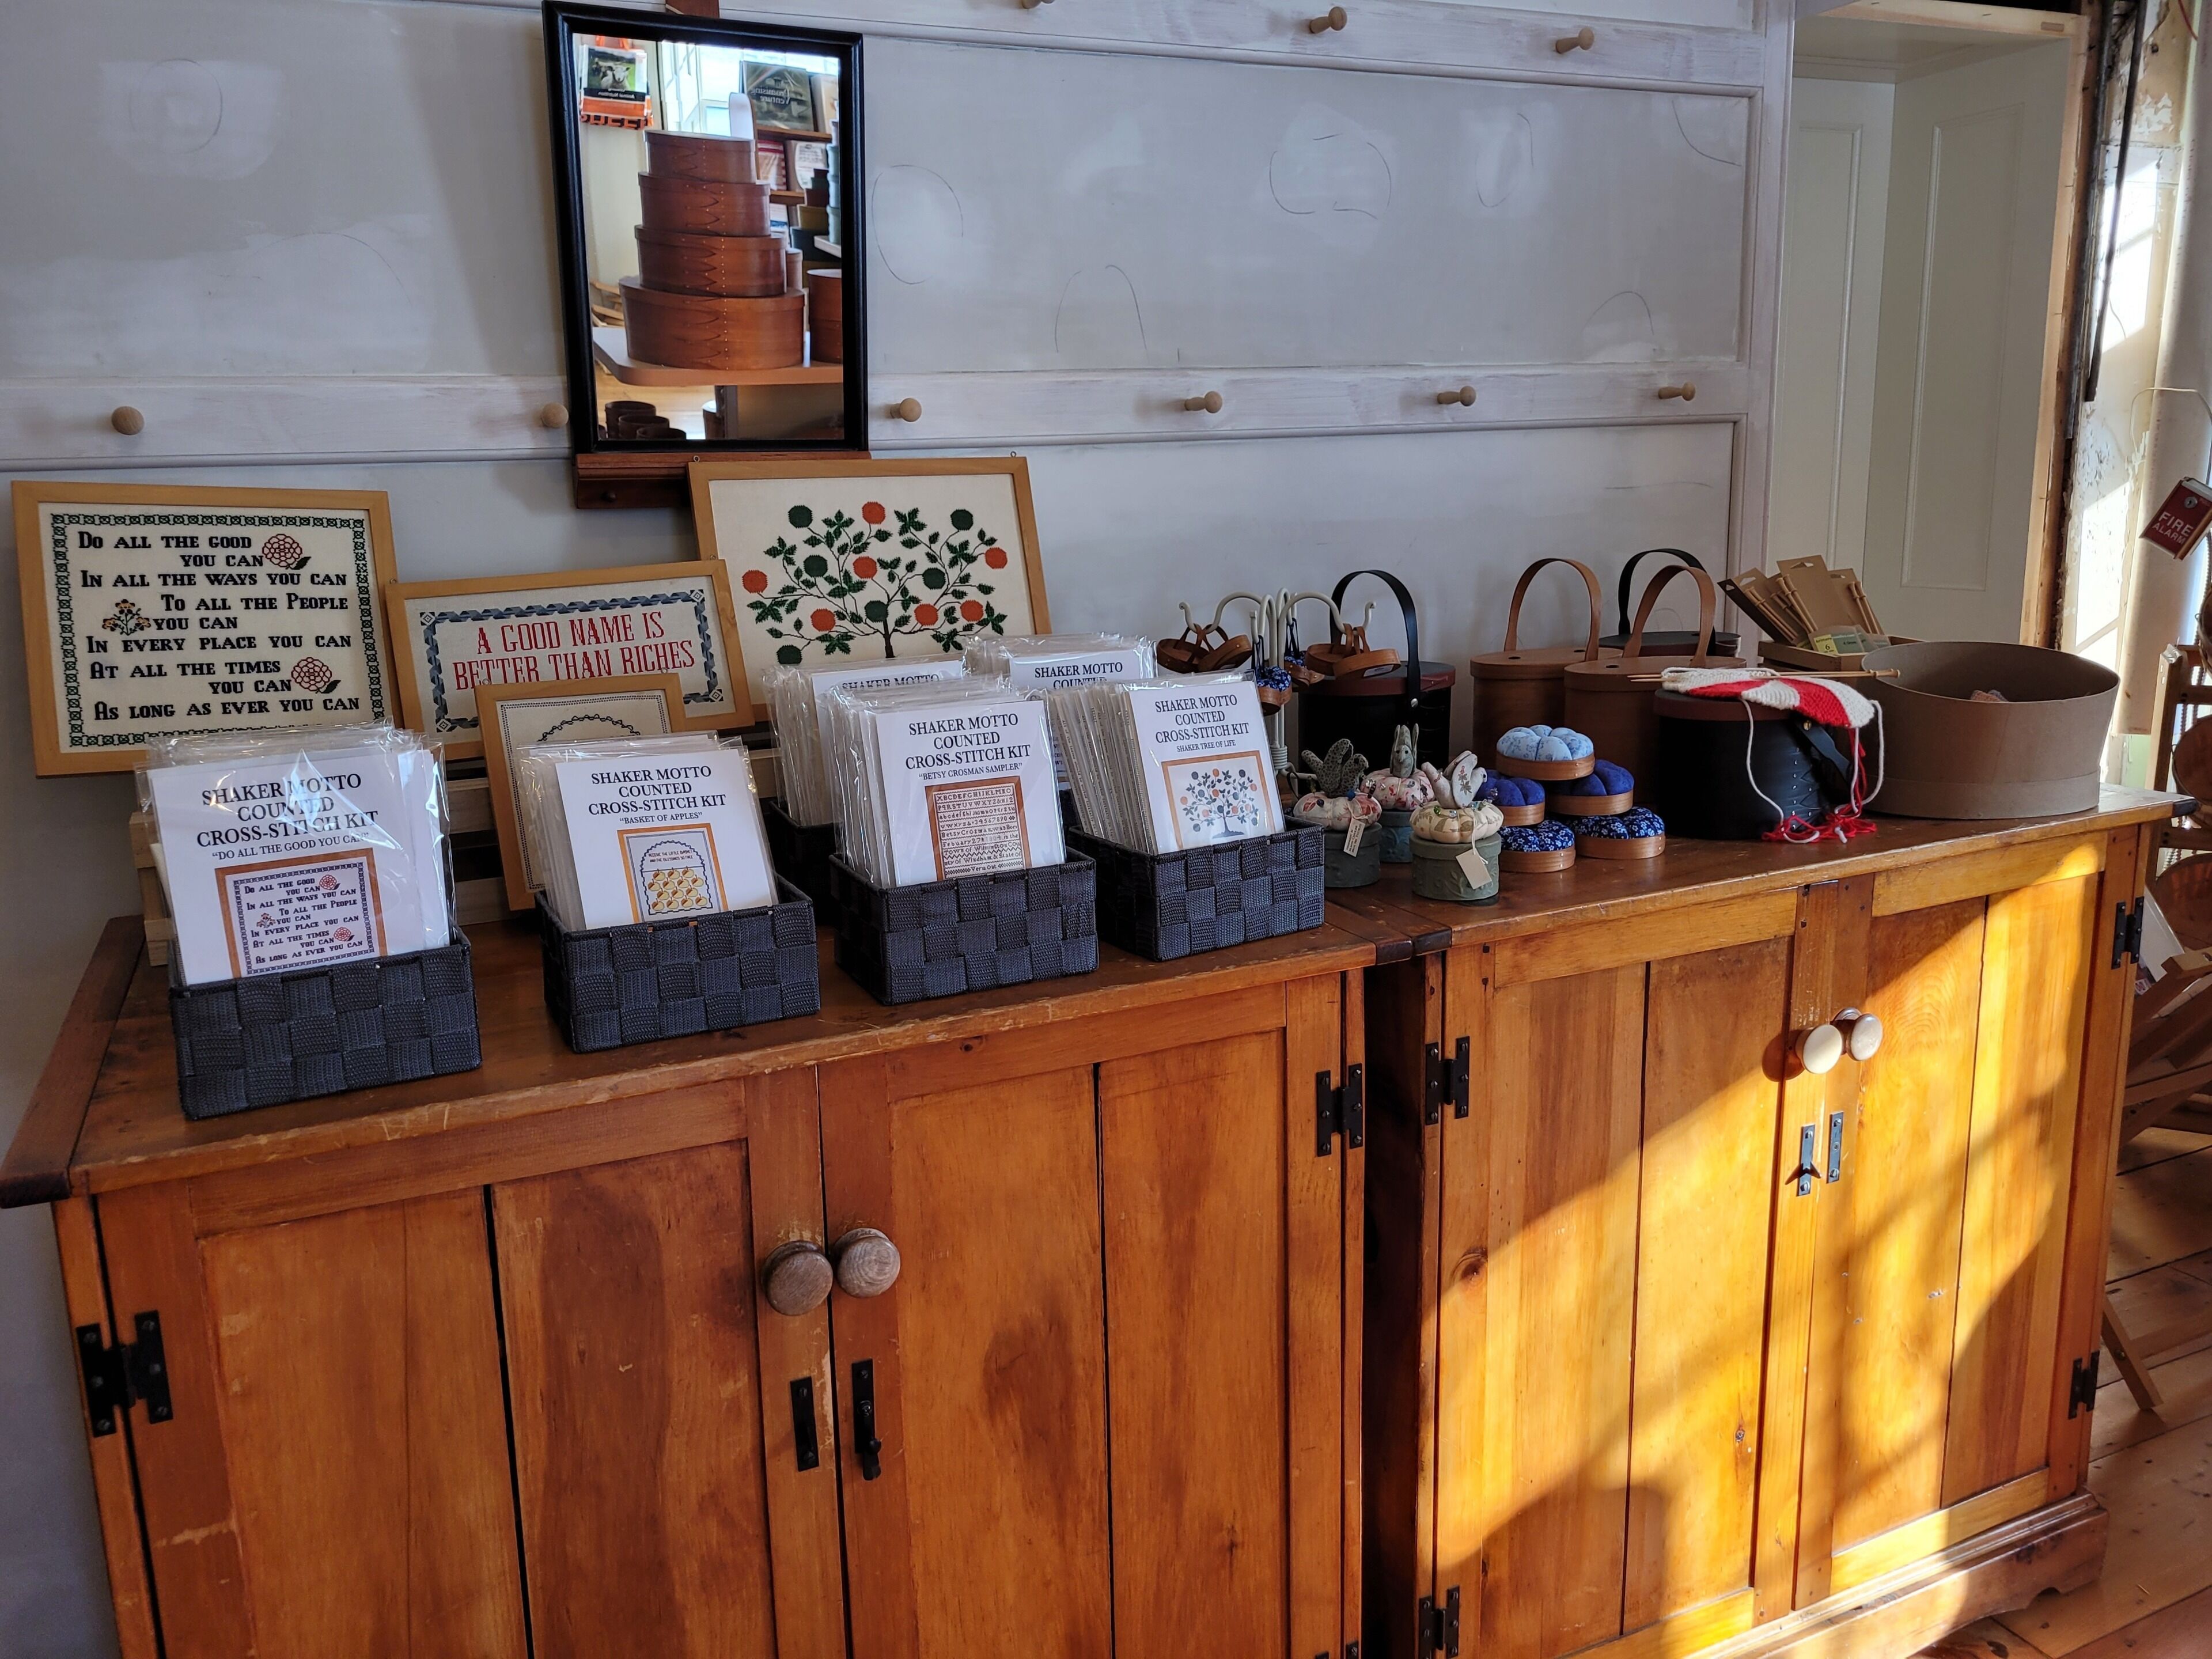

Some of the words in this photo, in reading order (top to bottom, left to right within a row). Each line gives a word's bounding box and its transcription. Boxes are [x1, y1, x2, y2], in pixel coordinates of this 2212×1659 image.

[2158, 511, 2194, 537] FIRE
[78, 531, 103, 548] DO
[114, 537, 151, 548] ALL
[161, 536, 199, 548] THE
[209, 537, 251, 548] GOOD
[2152, 522, 2186, 544] ALARM
[180, 555, 215, 567] YOU
[226, 555, 263, 567] CAN
[81, 570, 103, 587] IN
[112, 575, 150, 586] ALL
[158, 574, 196, 586] THE
[204, 574, 257, 585] WAYS
[266, 574, 301, 585] YOU
[310, 574, 347, 585] CAN
[161, 594, 185, 611] TO
[195, 599, 231, 611] ALL
[241, 598, 277, 609] THE
[286, 593, 348, 609] PEOPLE
[153, 618, 189, 630] YOU
[199, 617, 237, 629] CAN
[477, 627, 491, 654] A
[500, 620, 561, 652] GOOD
[569, 614, 635, 647] NAME
[642, 611, 665, 639] IS
[86, 636, 108, 653] IN
[122, 638, 185, 652] EVERY
[199, 637, 256, 650] PLACE
[268, 636, 303, 647] YOU
[315, 636, 351, 647] CAN
[90, 662, 118, 679] AT
[130, 665, 167, 677] ALL
[177, 663, 215, 676] THE
[225, 661, 281, 674] TIMES
[452, 656, 540, 690] BETTER
[548, 649, 612, 681] THAN
[619, 640, 695, 675] RICHES
[1035, 665, 1080, 678] SHAKER
[1083, 662, 1123, 675] MOTTO
[209, 681, 244, 694] YOU
[254, 680, 291, 692] CAN
[94, 702, 119, 720] AS
[129, 704, 175, 719] LONG
[187, 703, 211, 715] AS
[221, 700, 270, 714] EVER
[279, 699, 313, 712] YOU
[323, 698, 359, 711] CAN
[1155, 698, 1200, 713] SHAKER
[1199, 695, 1237, 709] MOTTO
[909, 718, 965, 736] SHAKER
[968, 714, 1018, 729] MOTTO
[1175, 711, 1225, 726] COUNTED
[934, 732, 999, 749] COUNTED
[1156, 725, 1230, 743] CROSS-STITCH
[1232, 723, 1249, 734] KIT
[1177, 743, 1199, 752] SHAKER
[1200, 741, 1215, 750] TREE
[906, 748, 1005, 770] CROSS-STITCH
[1007, 744, 1030, 758] KIT
[592, 770, 653, 785] SHAKER
[656, 766, 711, 780] MOTTO
[948, 767, 984, 777] CROSMAN
[202, 782, 284, 806] SHAKER
[289, 773, 361, 796] MOTTO
[619, 782, 692, 797] COUNTED
[238, 796, 334, 822] COUNTED
[589, 798, 698, 815] CROSS-STITCH
[700, 794, 726, 807] KIT
[197, 817, 341, 847] CROSS-STITCH
[344, 811, 378, 829] KIT
[237, 848, 258, 858] ALL
[259, 844, 282, 855] THE
[285, 839, 316, 851] GOOD
[318, 836, 341, 847] YOU
[247, 903, 255, 911] IN
[296, 895, 318, 903] WAYS
[331, 899, 357, 908] PEOPLE
[265, 926, 290, 935] EVERY
[296, 922, 319, 930] PLACE
[253, 940, 264, 948] AT
[306, 931, 329, 939] TIMES
[256, 956, 266, 964] AS
[270, 953, 287, 961] LONG
[306, 947, 325, 956] EVER
